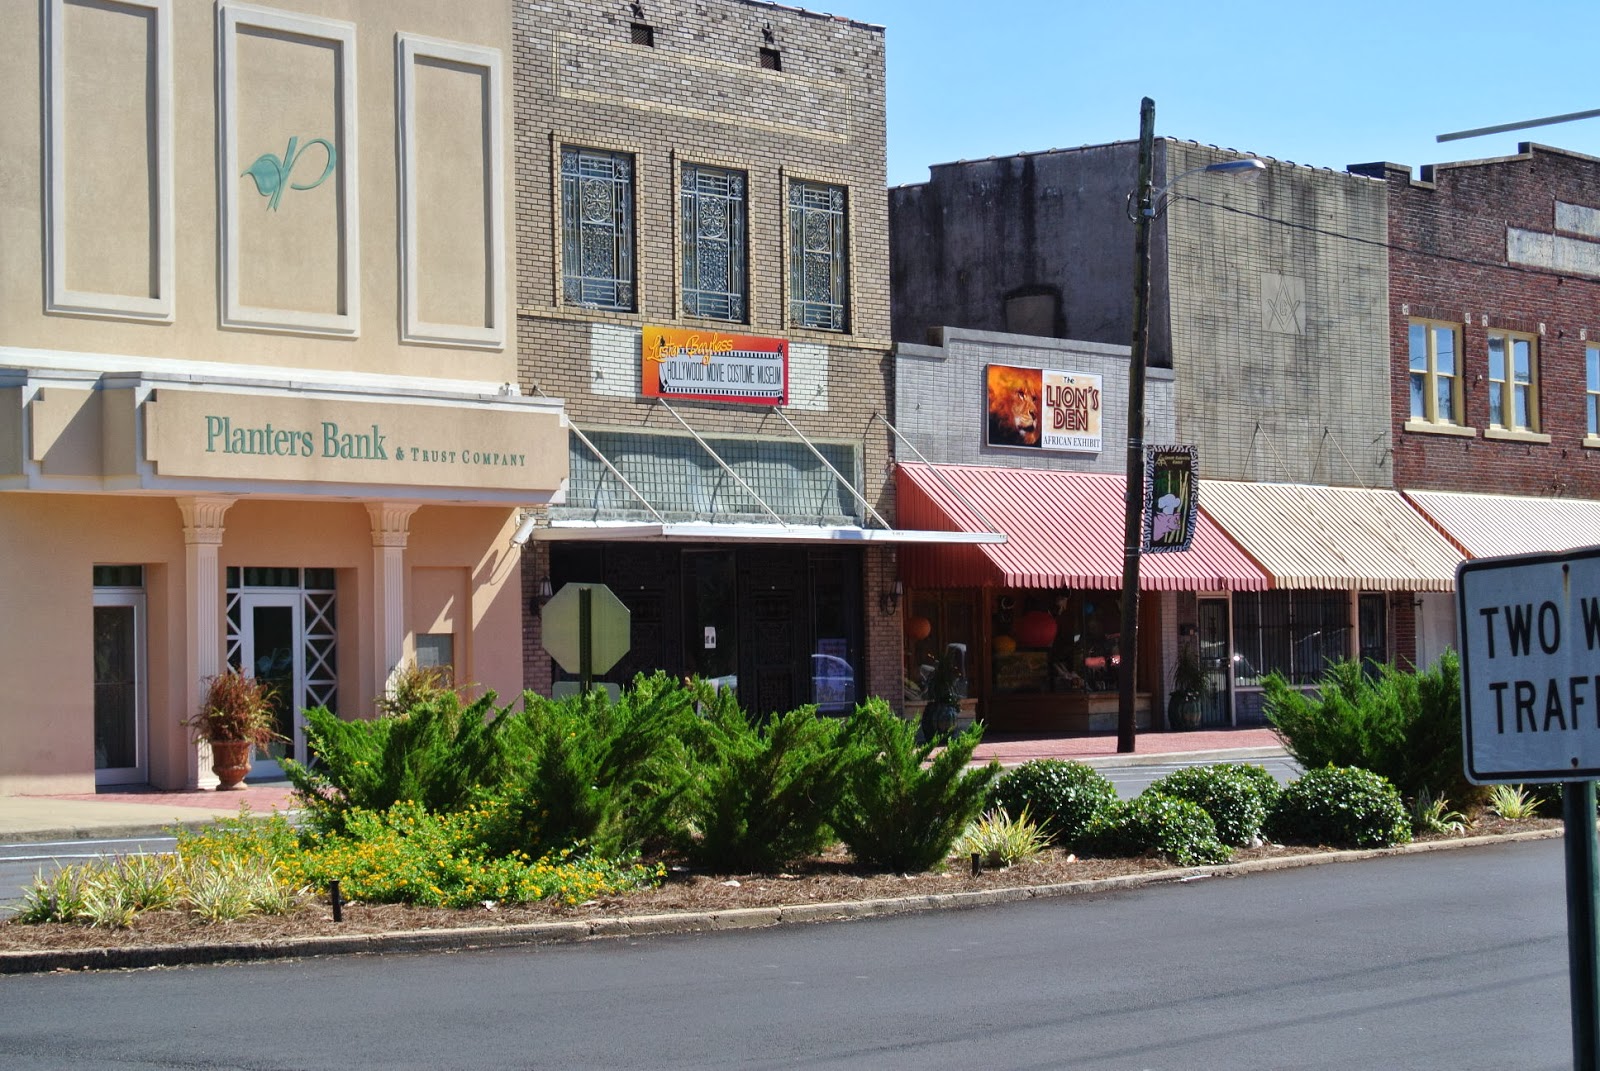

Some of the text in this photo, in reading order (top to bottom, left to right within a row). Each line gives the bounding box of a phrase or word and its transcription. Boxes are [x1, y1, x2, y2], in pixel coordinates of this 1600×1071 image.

[685, 332, 734, 365] Bayless
[667, 361, 782, 385] HOLLYWOOD MOVIE COSTUME MUSEUM
[1063, 376, 1075, 385] The
[1046, 385, 1099, 411] LION'S
[1053, 407, 1088, 431] DEN
[205, 415, 314, 457] Planters
[321, 421, 388, 460] Bank
[395, 447, 405, 461] &
[1043, 435, 1100, 448] AFRICAN EXHIBIT
[1479, 600, 1561, 659] TWO
[1489, 675, 1600, 734] TRAF
